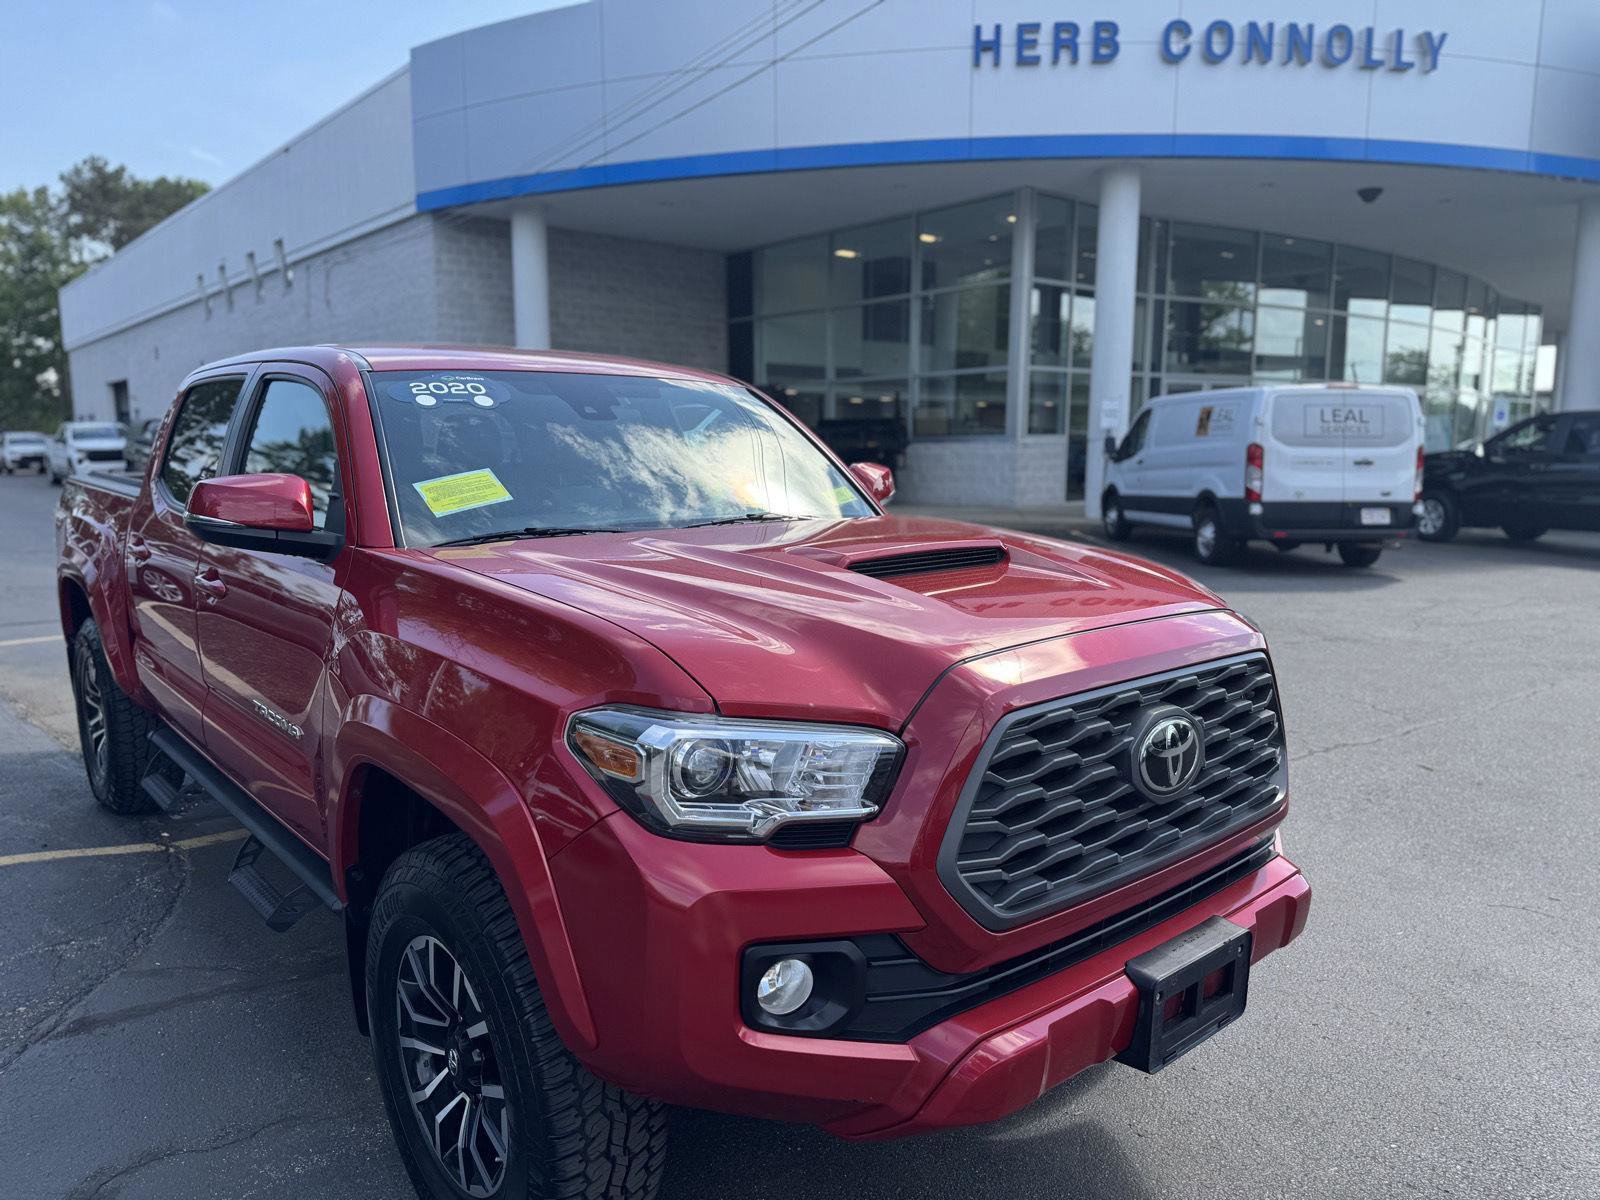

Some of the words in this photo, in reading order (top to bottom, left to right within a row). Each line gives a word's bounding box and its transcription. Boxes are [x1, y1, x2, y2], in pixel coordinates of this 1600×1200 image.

[973, 21, 1120, 66] HERB
[1162, 19, 1448, 72] CONNOLLY
[409, 382, 486, 395] 2020
[1320, 408, 1370, 423] LEAL
[250, 699, 304, 739] TACOMA
